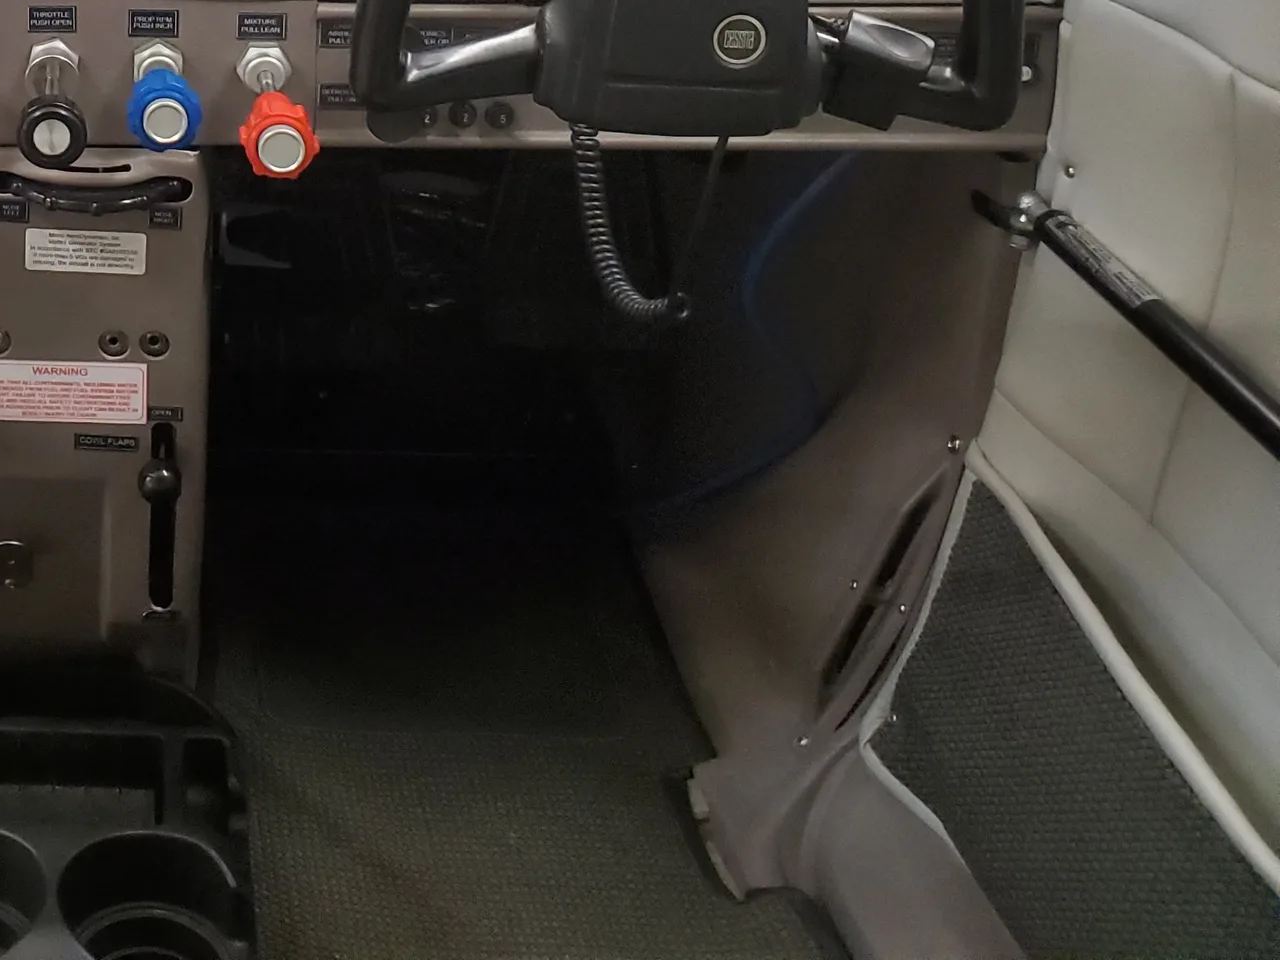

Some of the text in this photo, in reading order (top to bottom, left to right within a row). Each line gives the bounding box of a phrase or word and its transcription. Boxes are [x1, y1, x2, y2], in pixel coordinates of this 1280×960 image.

[260, 26, 281, 34] LEAN
[32, 366, 89, 377] WARNING
[80, 436, 136, 447] COWL FLAPS
